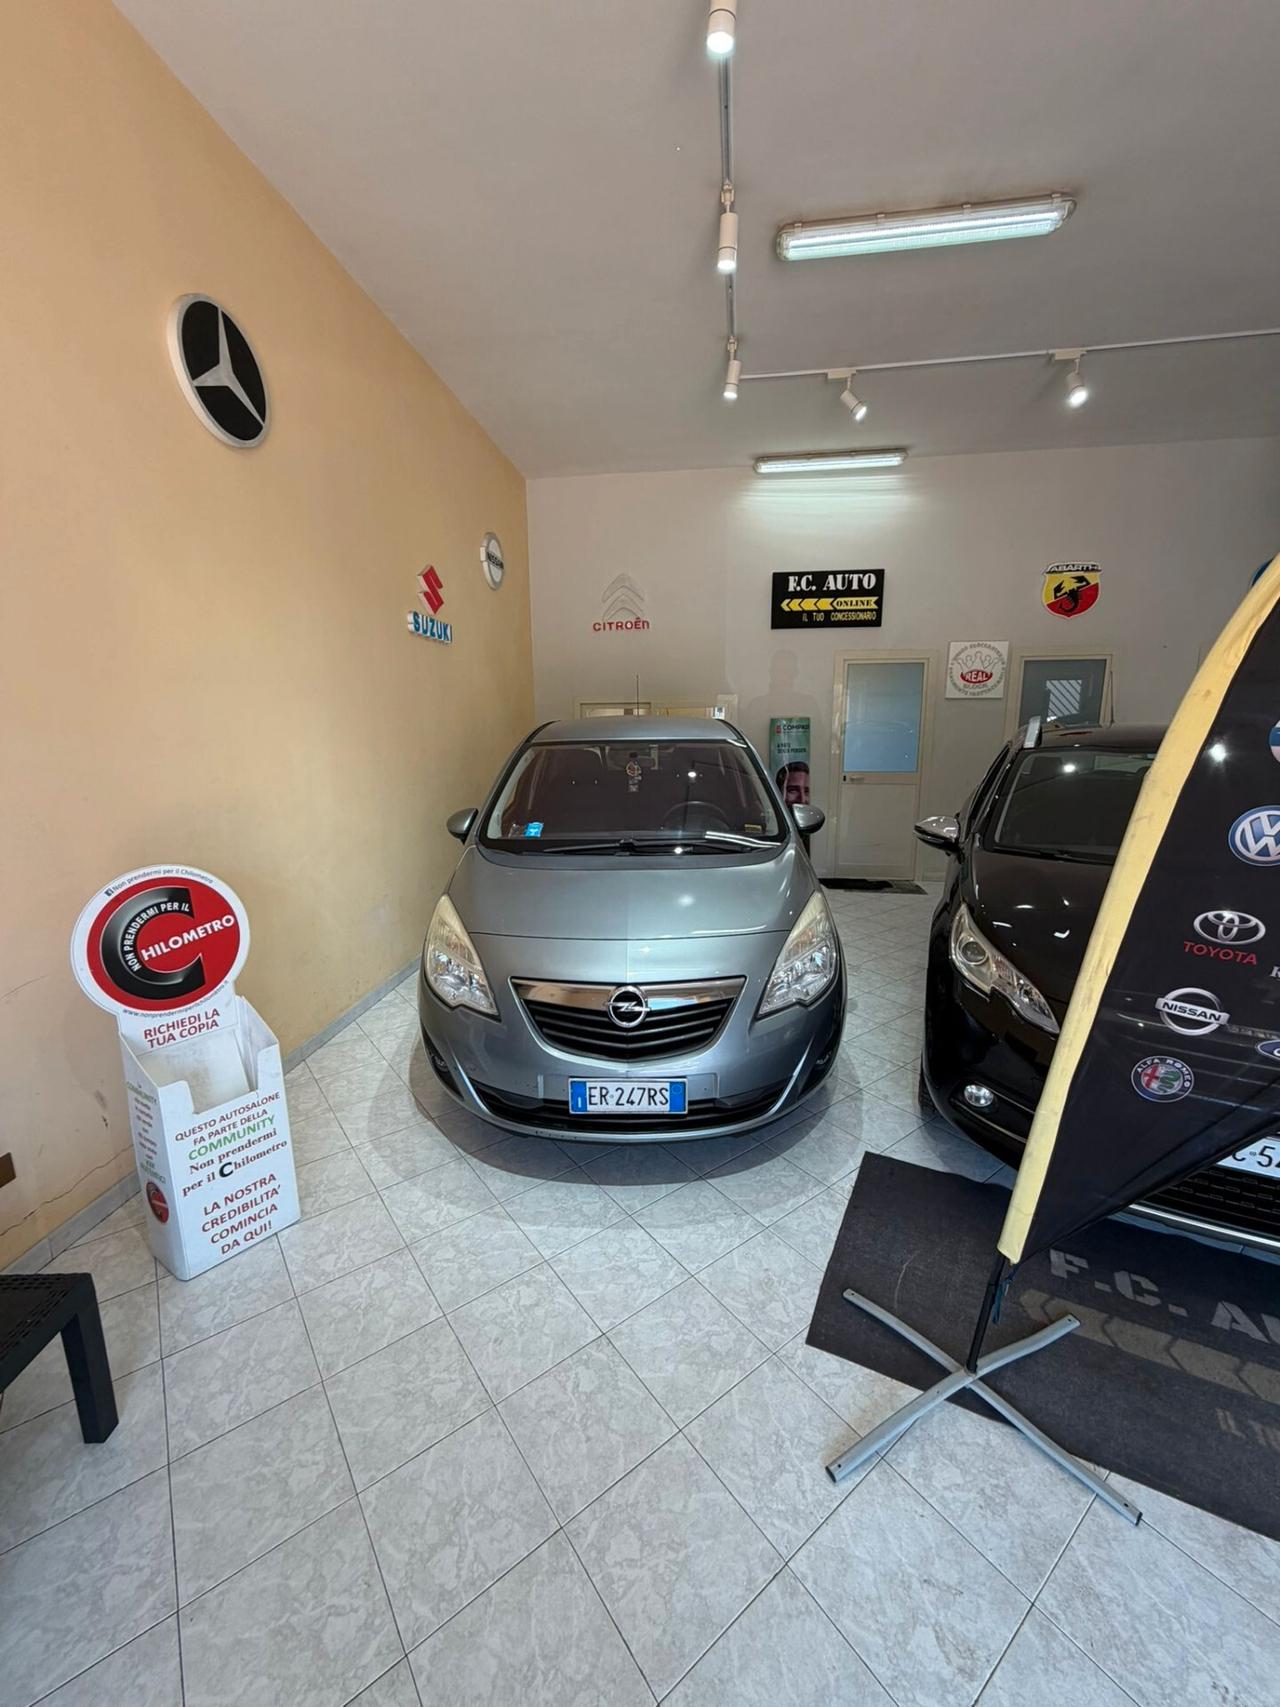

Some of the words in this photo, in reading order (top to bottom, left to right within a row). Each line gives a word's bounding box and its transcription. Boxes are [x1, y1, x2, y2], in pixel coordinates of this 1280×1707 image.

[788, 575, 816, 591] F.C.
[823, 573, 876, 590] AUTO
[802, 613, 808, 622] IL
[813, 612, 824, 621] TUO
[830, 611, 877, 621] CONCESSIONARIO
[836, 599, 872, 607] ONLINE
[413, 611, 452, 643] SUZUKI
[965, 671, 988, 682] REAL
[160, 902, 179, 911] PER
[181, 902, 190, 911] IL
[124, 906, 159, 951] PRENDERMI
[124, 952, 142, 972] NON
[1184, 941, 1257, 965] TOYOTA
[144, 1013, 201, 1039] RICHIEDI
[205, 1008, 220, 1020] LA
[1162, 1001, 1221, 1021] NISSAN
[147, 1032, 177, 1049] TUA
[179, 1019, 220, 1038] COPIA
[1136, 1058, 1160, 1073] ALFA
[1166, 1059, 1191, 1088] ROMEO
[175, 1119, 217, 1141] QUESTO
[218, 1091, 281, 1123] AUTOSALONE
[193, 1136, 206, 1146] FA
[207, 1122, 238, 1140] PARTE
[240, 1109, 268, 1126] DELLA
[188, 1115, 275, 1161] COMMUNITY
[189, 1158, 215, 1174] Non
[217, 1127, 277, 1163] prendermi
[182, 1180, 203, 1198] per
[207, 1172, 216, 1183] il
[219, 1141, 288, 1178] Chilometro
[1256, 1145, 1280, 1168] 5
[202, 1184, 280, 1232] CREDIBILITA'
[204, 1202, 221, 1216] LA
[224, 1174, 277, 1206] NOSTRA
[211, 1203, 278, 1244] COMINCIA
[221, 1239, 241, 1254] DA
[244, 1220, 272, 1242] QUI!
